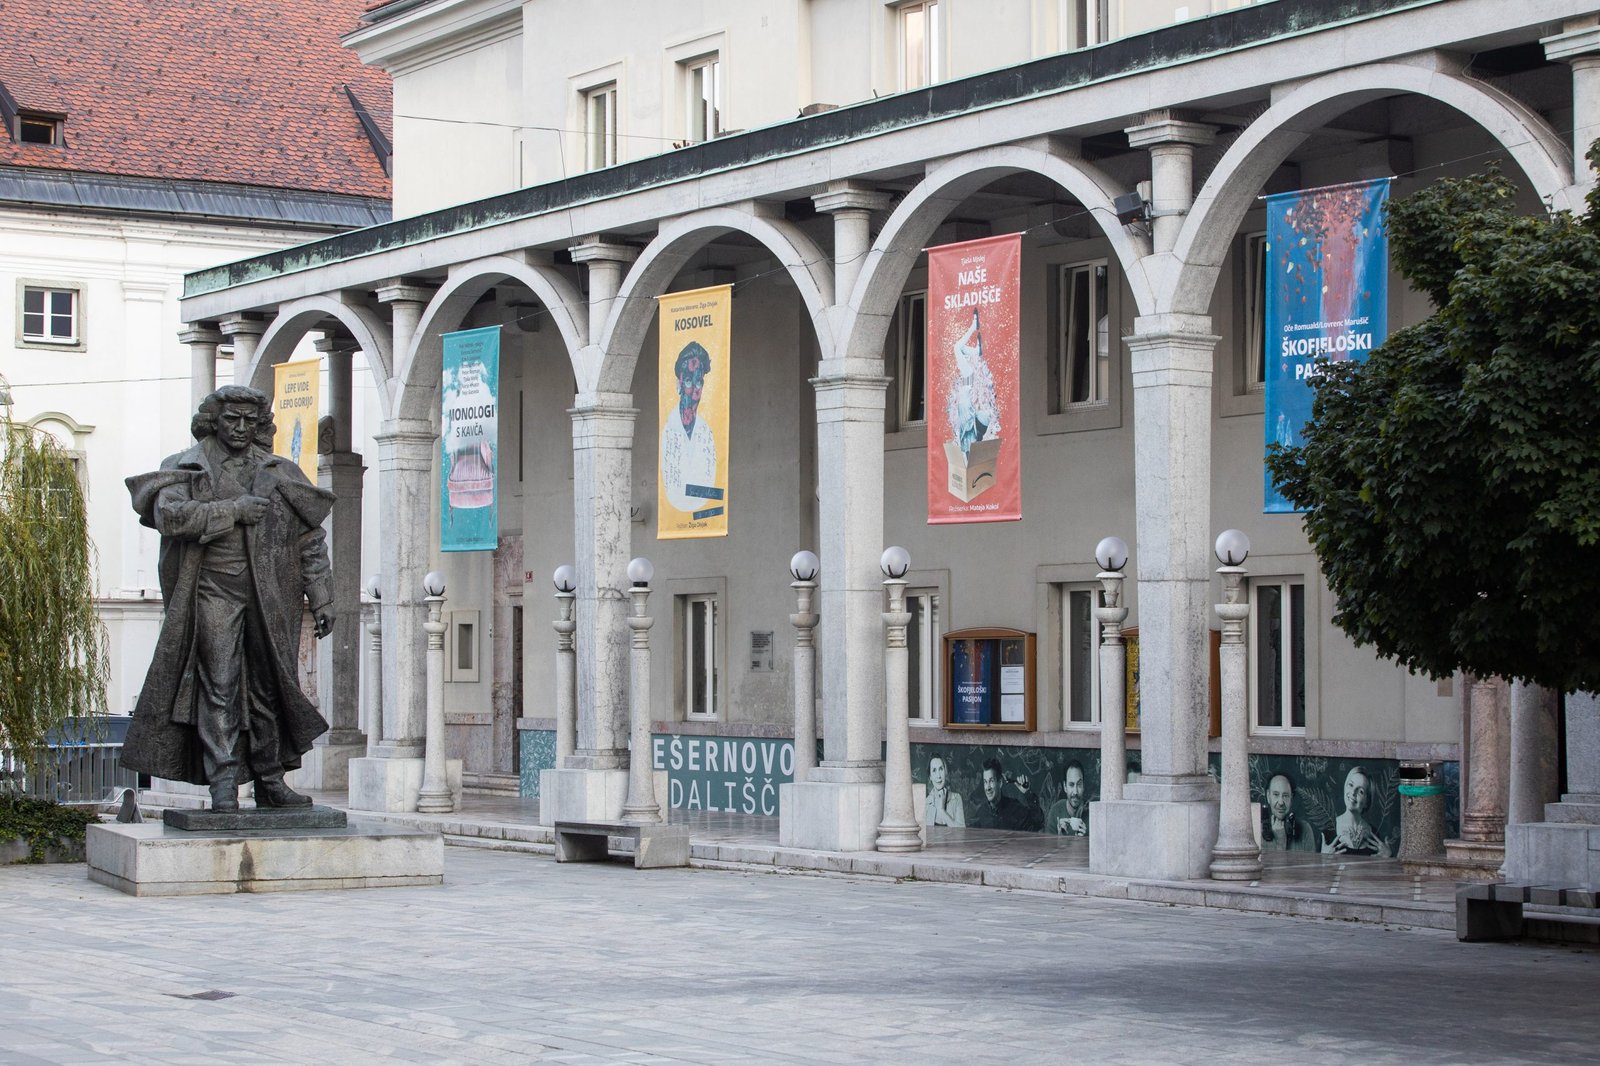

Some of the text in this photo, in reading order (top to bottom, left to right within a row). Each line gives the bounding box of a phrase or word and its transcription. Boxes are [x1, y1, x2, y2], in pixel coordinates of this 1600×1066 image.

[958, 265, 987, 287] NAŠE
[944, 285, 1001, 310] SKLADIŠČE
[674, 314, 714, 332] KOSOVEL
[1283, 324, 1294, 332] Oče
[1344, 316, 1369, 326] Marušič
[1282, 329, 1372, 358] ŠKOFJELOŠKI
[285, 381, 310, 394] LEPE VIDE
[280, 398, 293, 409] LEPO
[449, 405, 494, 421] MONOLOGI
[456, 421, 484, 438] S KAVČA
[628, 735, 795, 776] EŠERNOVO
[670, 777, 775, 816] DALIŠČ
